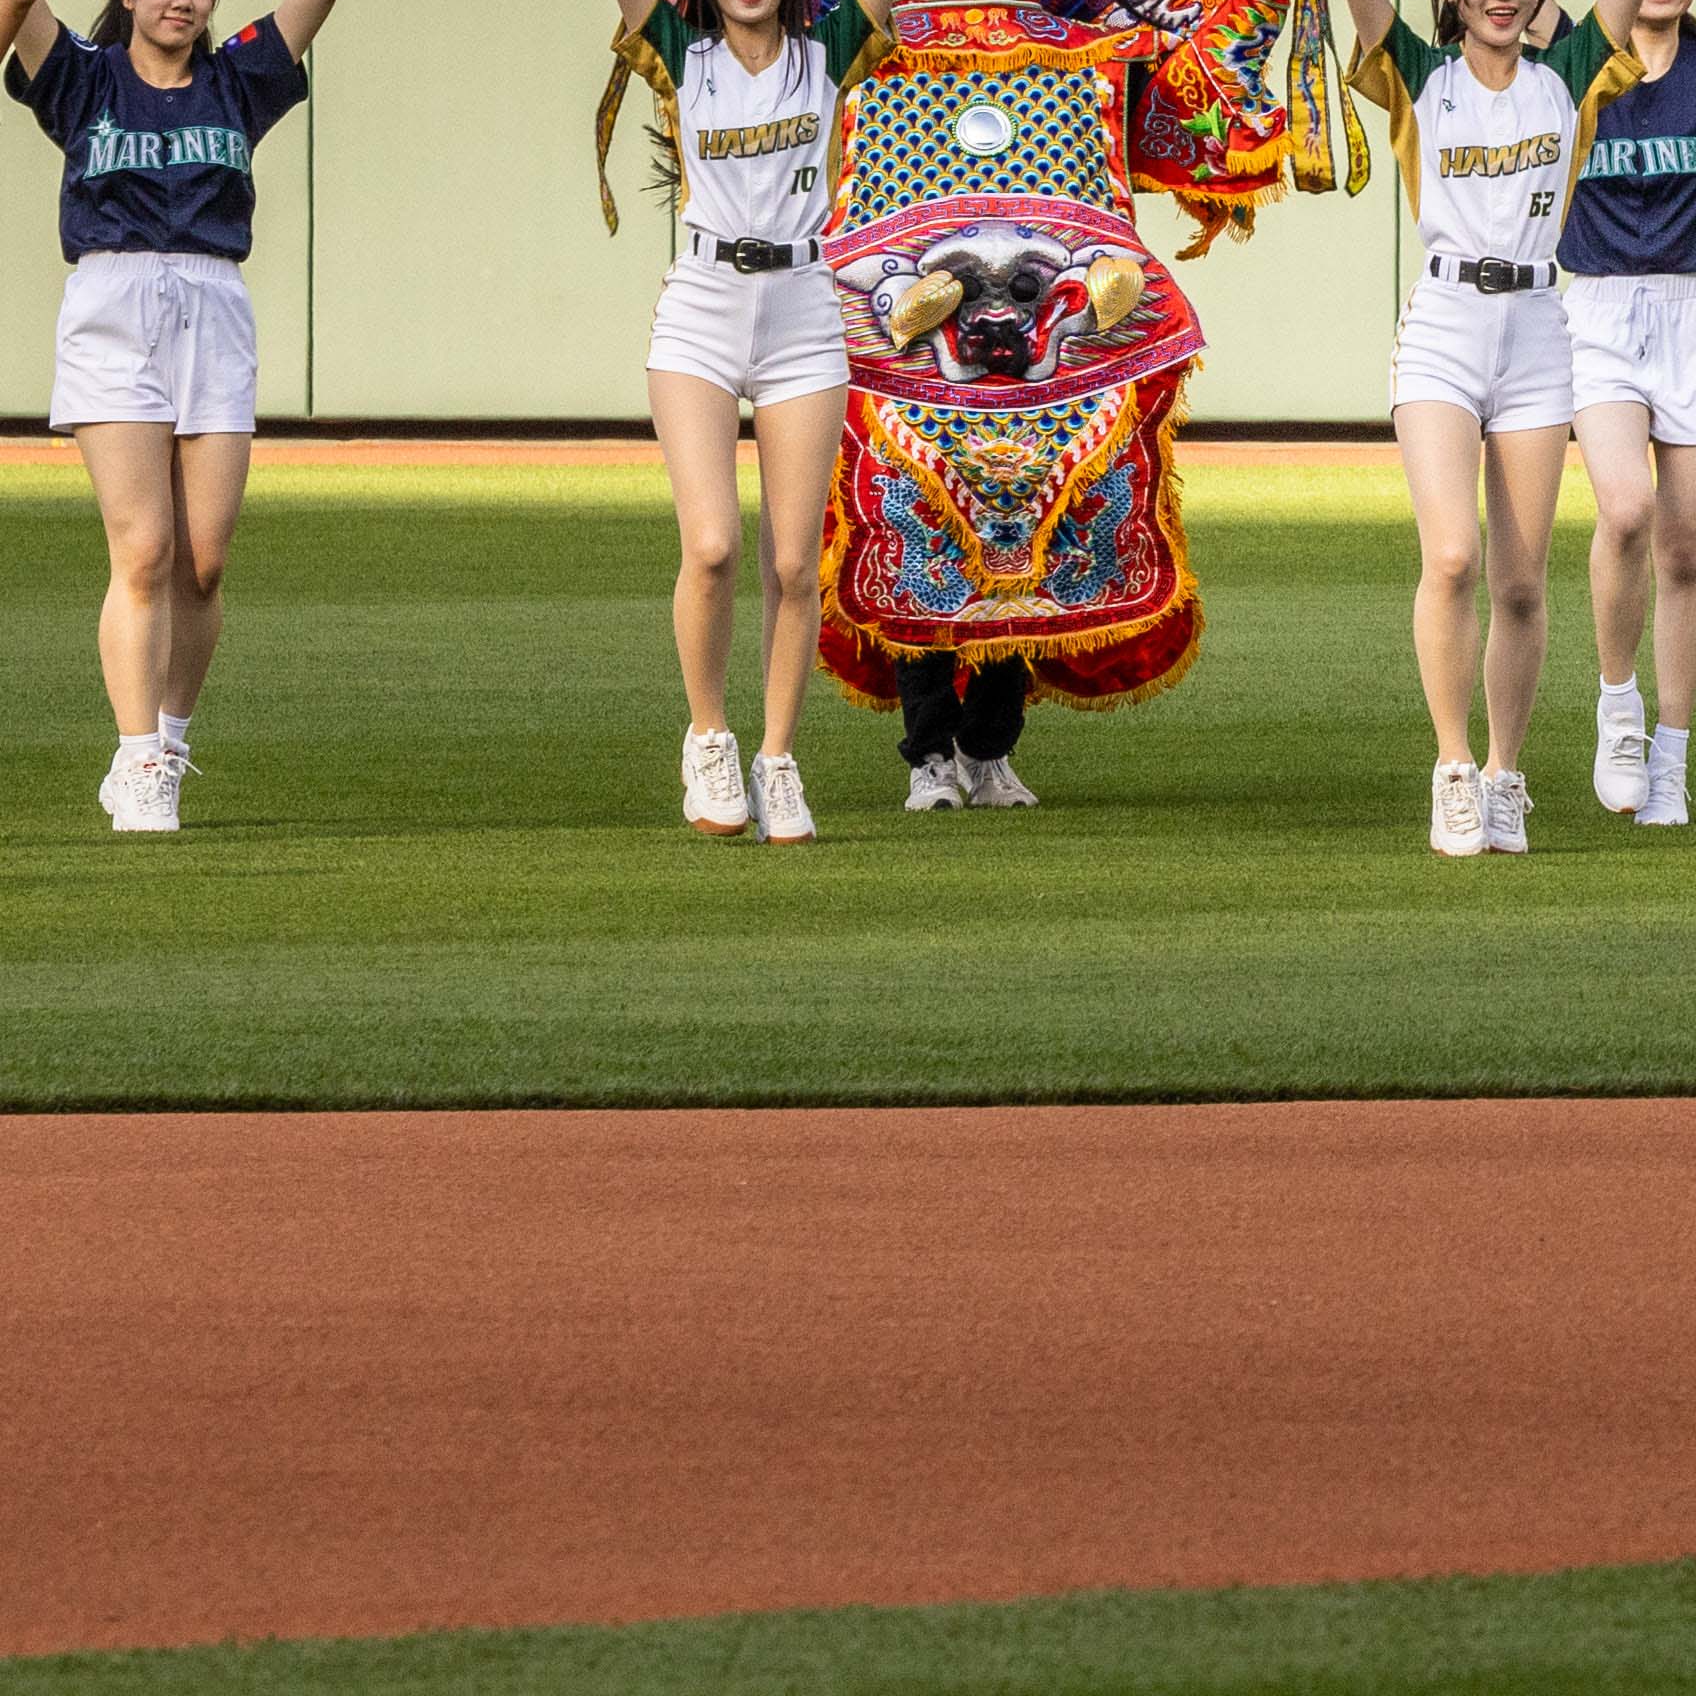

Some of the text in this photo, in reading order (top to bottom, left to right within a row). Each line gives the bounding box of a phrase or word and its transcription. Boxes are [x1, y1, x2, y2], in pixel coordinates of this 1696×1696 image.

[82, 124, 251, 181] MARINER
[696, 111, 821, 161] HAWKS
[1439, 131, 1561, 179] HAWKS
[789, 165, 818, 196] 10
[1528, 191, 1555, 219] 62
